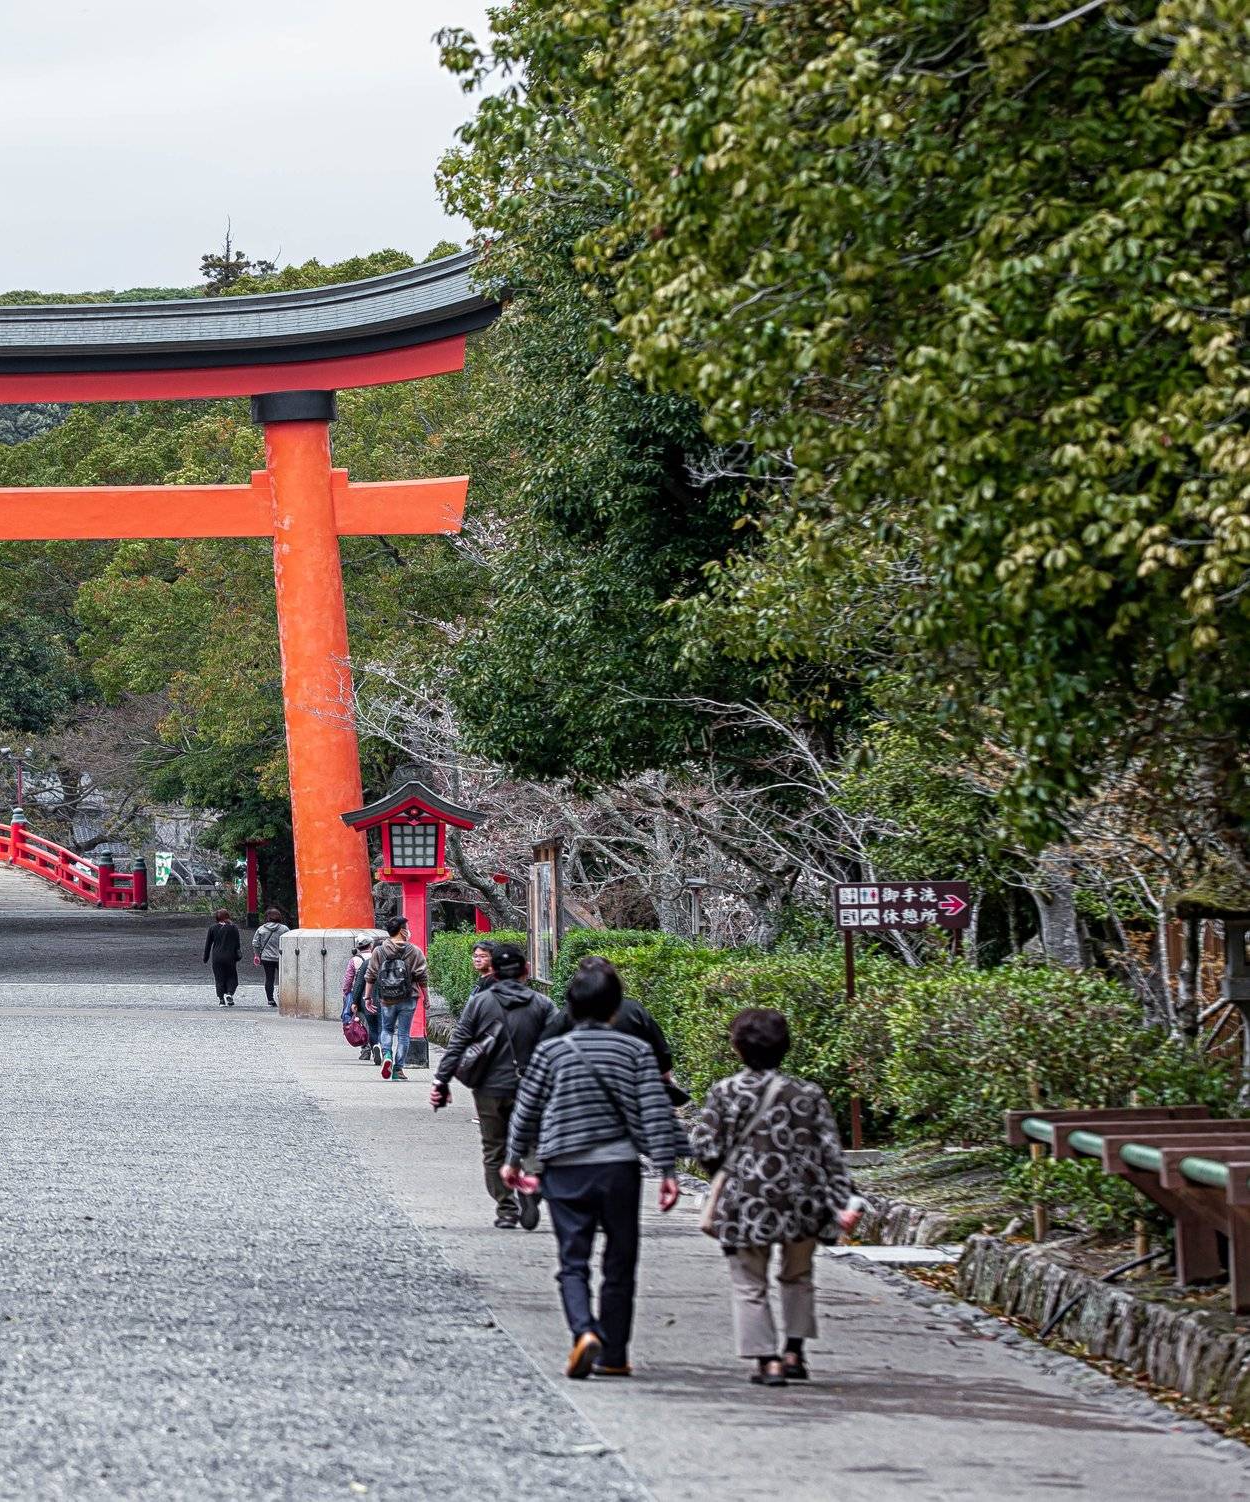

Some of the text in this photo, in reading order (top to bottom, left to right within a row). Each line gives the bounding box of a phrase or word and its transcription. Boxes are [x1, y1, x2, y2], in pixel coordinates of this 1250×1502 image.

[881, 887, 938, 903] 御手洗
[881, 909, 938, 924] 休憩所
